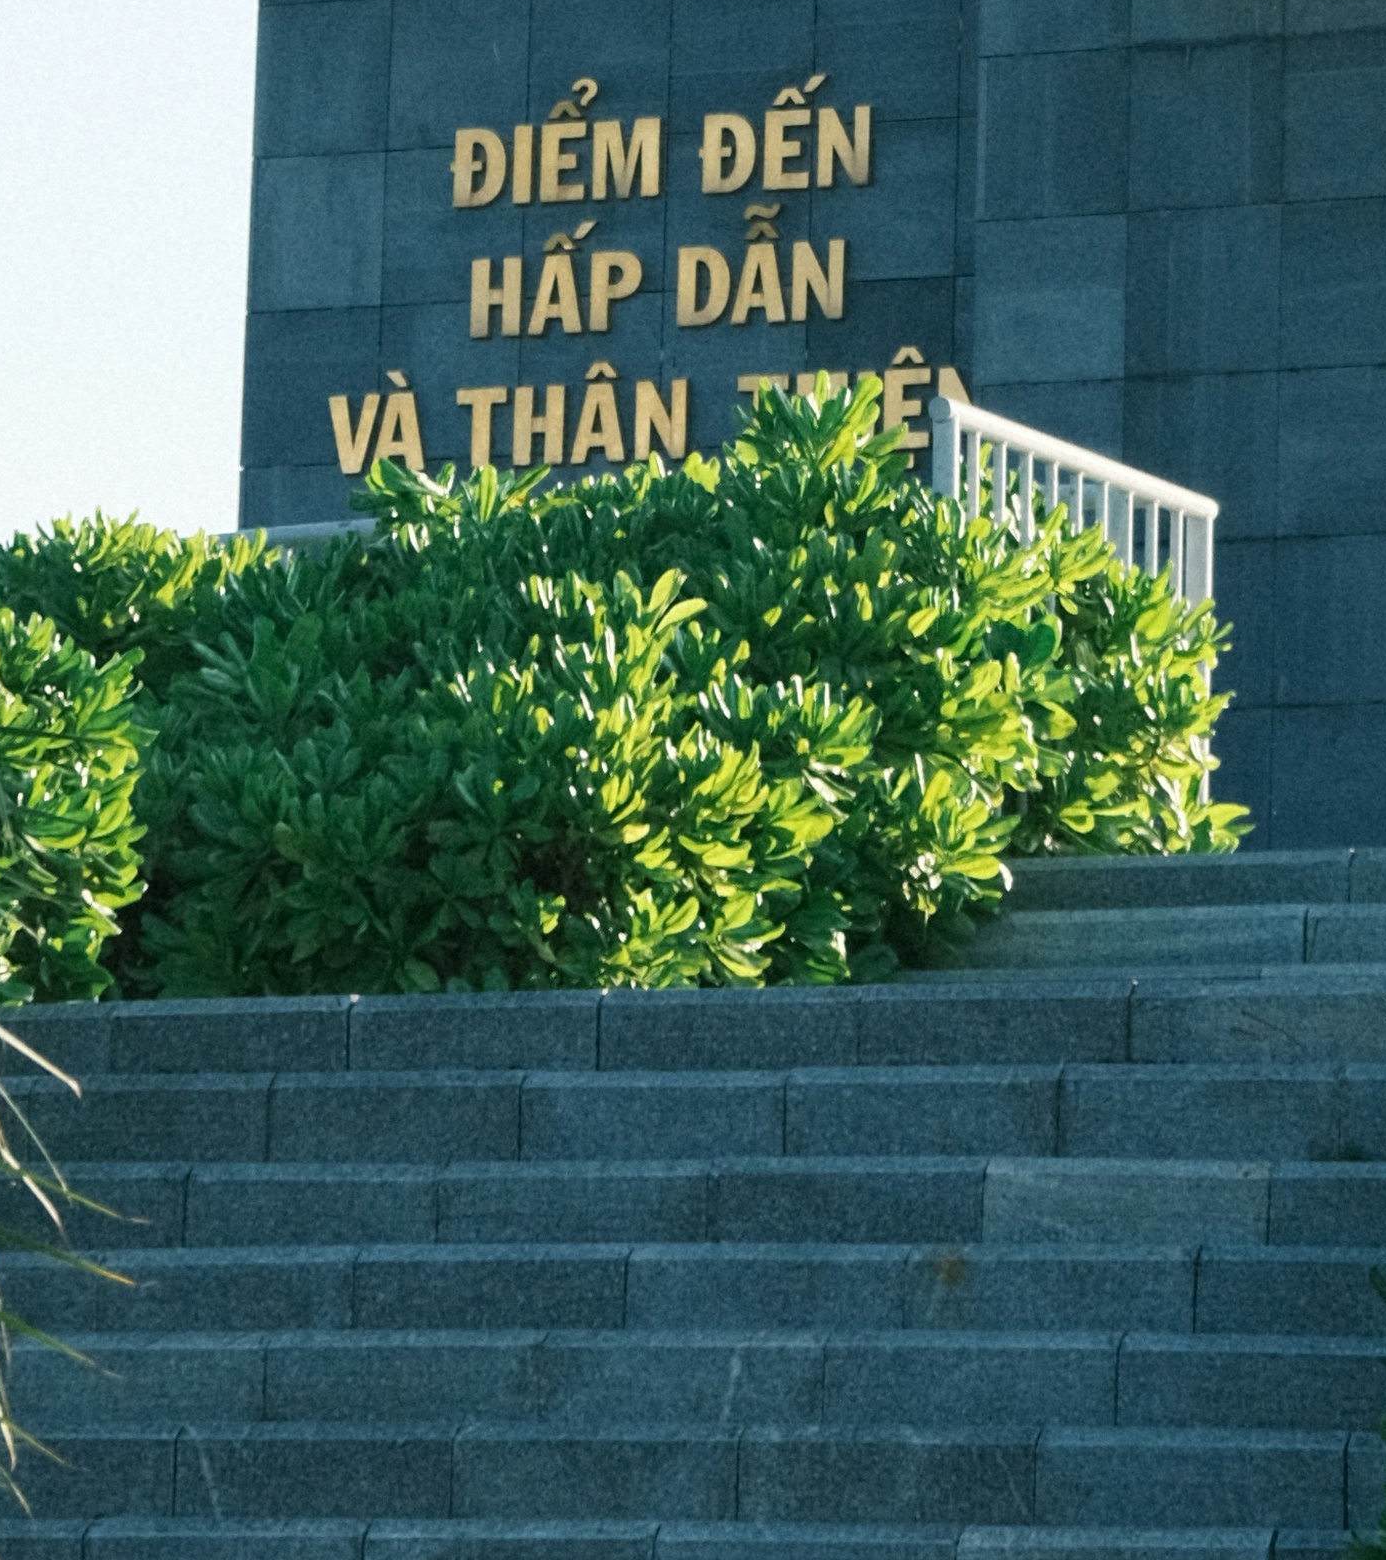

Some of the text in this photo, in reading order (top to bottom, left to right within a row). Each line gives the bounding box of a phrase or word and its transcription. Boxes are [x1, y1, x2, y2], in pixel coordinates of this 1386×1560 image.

[449, 72, 872, 208] ĐIỂM ĐẾN
[469, 202, 846, 339] HẤP DẪN
[327, 368, 425, 475] VÀ
[455, 359, 688, 468] THÂN
